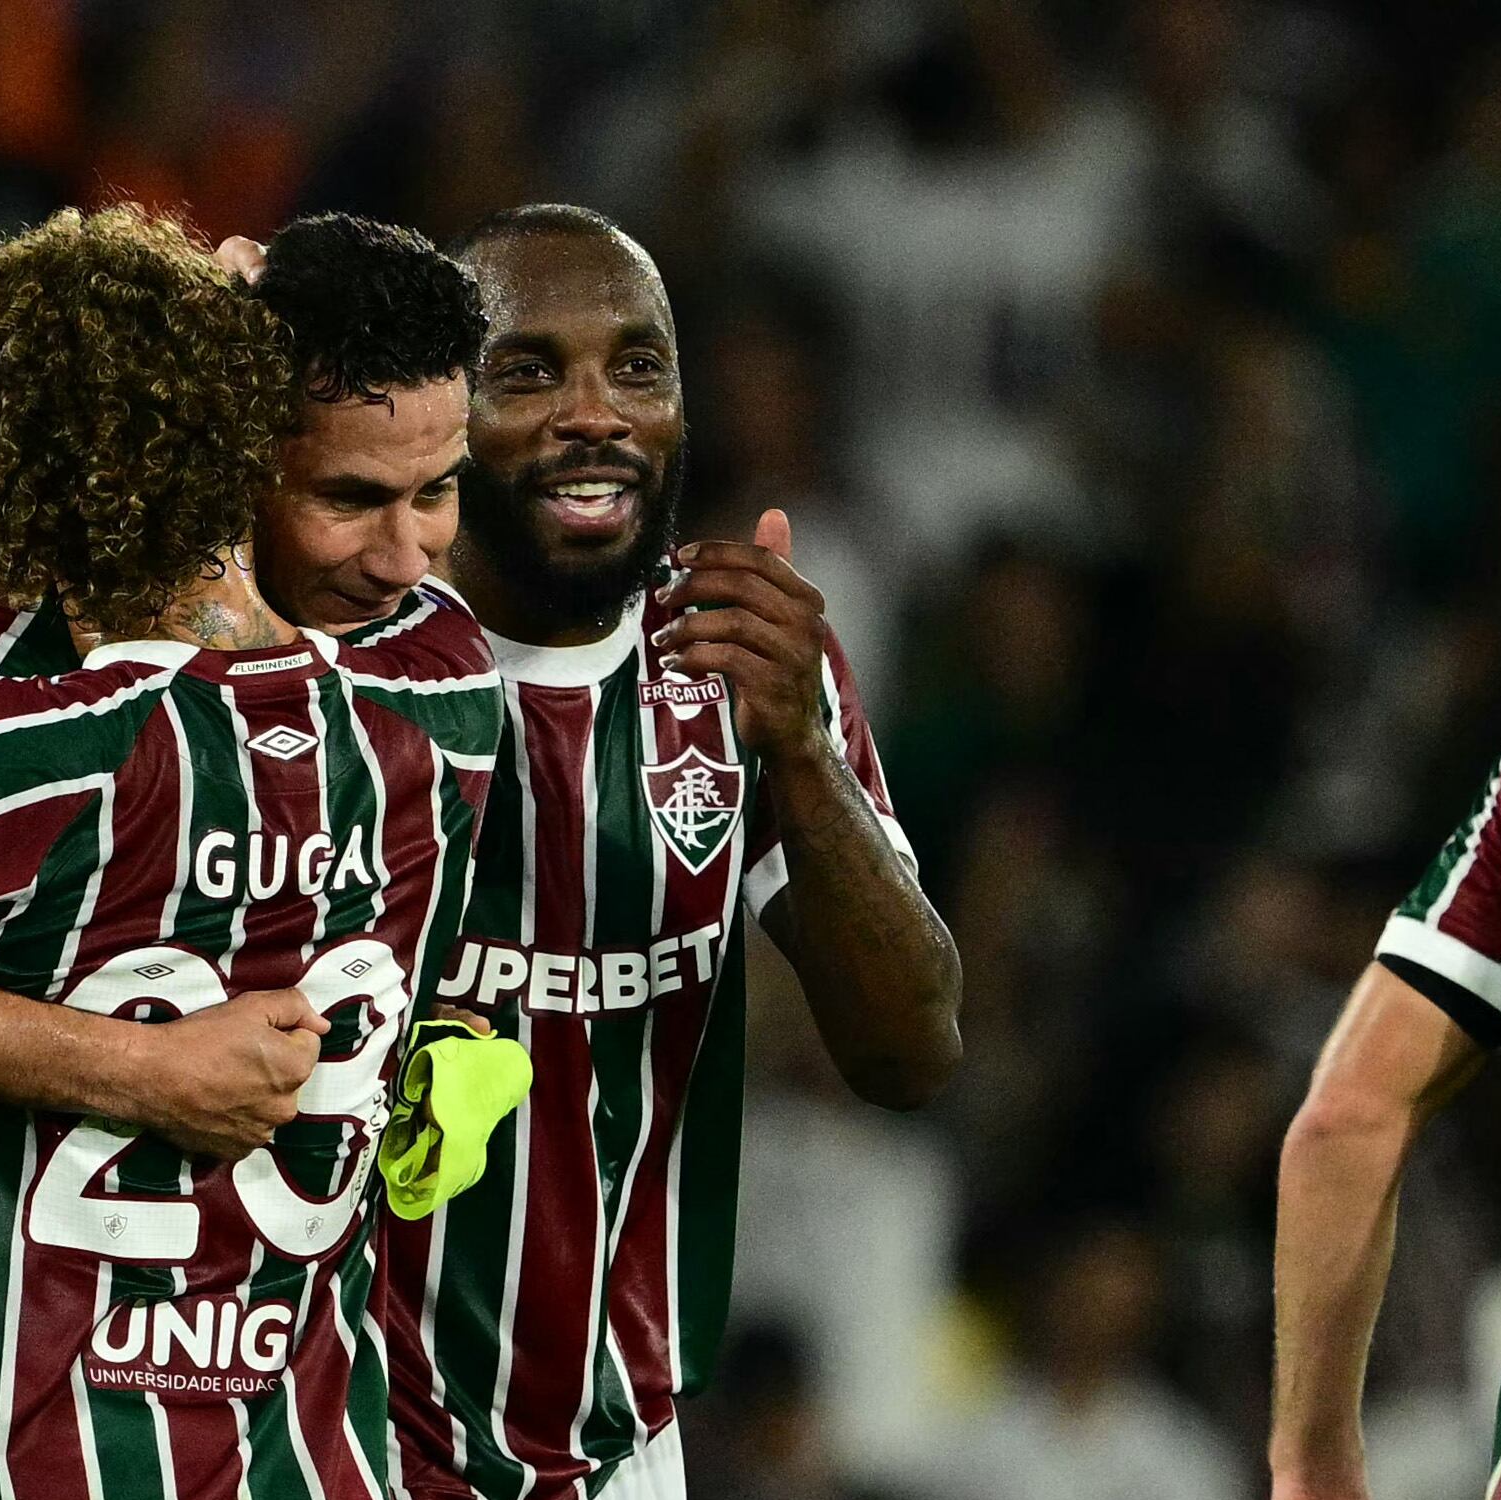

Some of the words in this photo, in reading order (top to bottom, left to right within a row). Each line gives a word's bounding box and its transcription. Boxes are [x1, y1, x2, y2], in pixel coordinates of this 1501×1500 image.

[642, 680, 721, 703] FRECATTO
[195, 824, 373, 900] GUGA
[91, 1299, 293, 1372] UNIG
[89, 1368, 221, 1392] UNIVERSIDADE
